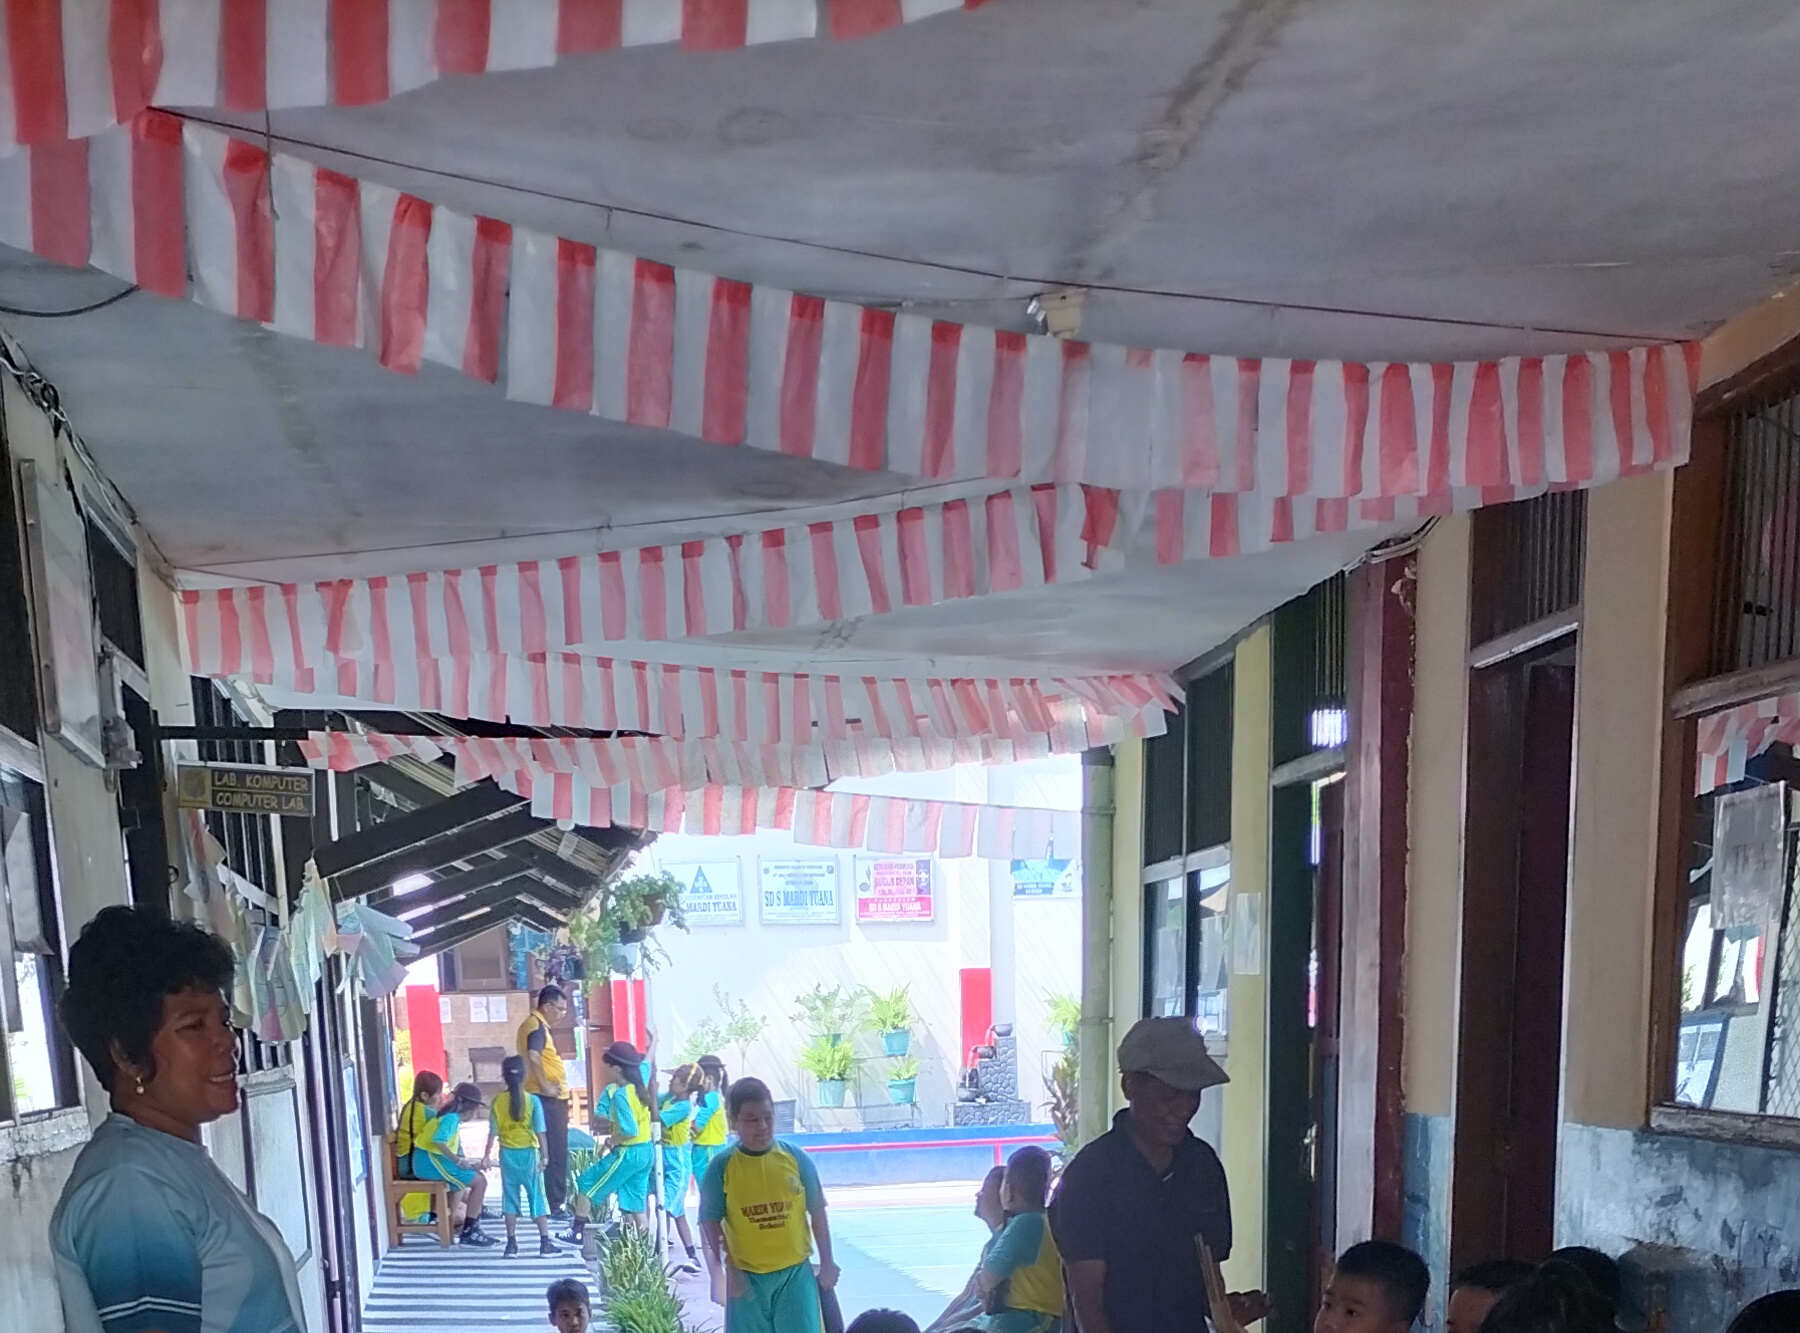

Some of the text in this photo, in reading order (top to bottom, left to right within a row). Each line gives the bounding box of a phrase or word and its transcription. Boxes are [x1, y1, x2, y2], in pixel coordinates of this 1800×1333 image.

[214, 771, 308, 791] LAB. KOMPUTER
[216, 792, 308, 811] COMPUTER LAB.
[764, 890, 775, 907] SD
[776, 890, 782, 907] S
[783, 890, 808, 906] MARDI
